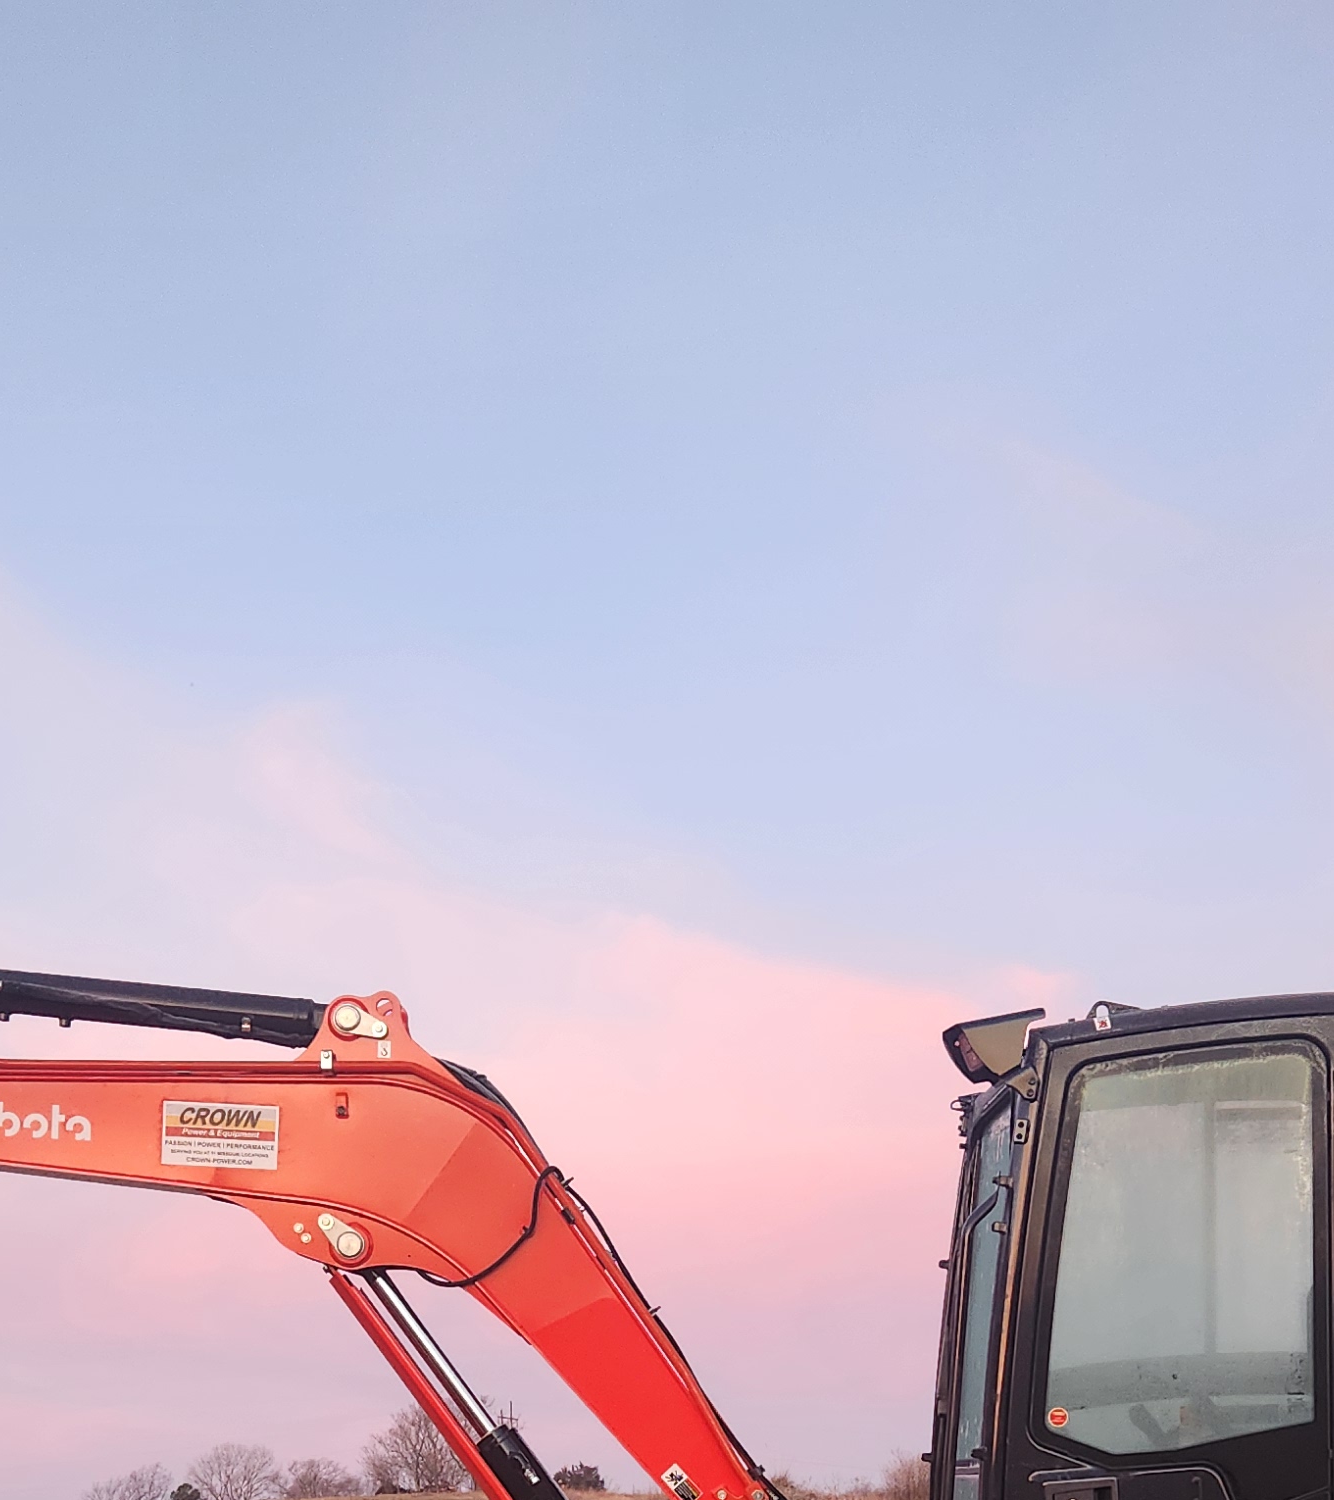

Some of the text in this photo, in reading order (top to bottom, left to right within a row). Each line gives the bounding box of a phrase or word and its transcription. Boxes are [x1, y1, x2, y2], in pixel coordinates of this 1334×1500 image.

[179, 1107, 262, 1128] CROWN
[182, 1128, 207, 1136] Power
[216, 1129, 260, 1139] Equipment
[226, 1142, 275, 1151] PERFORMANCE
